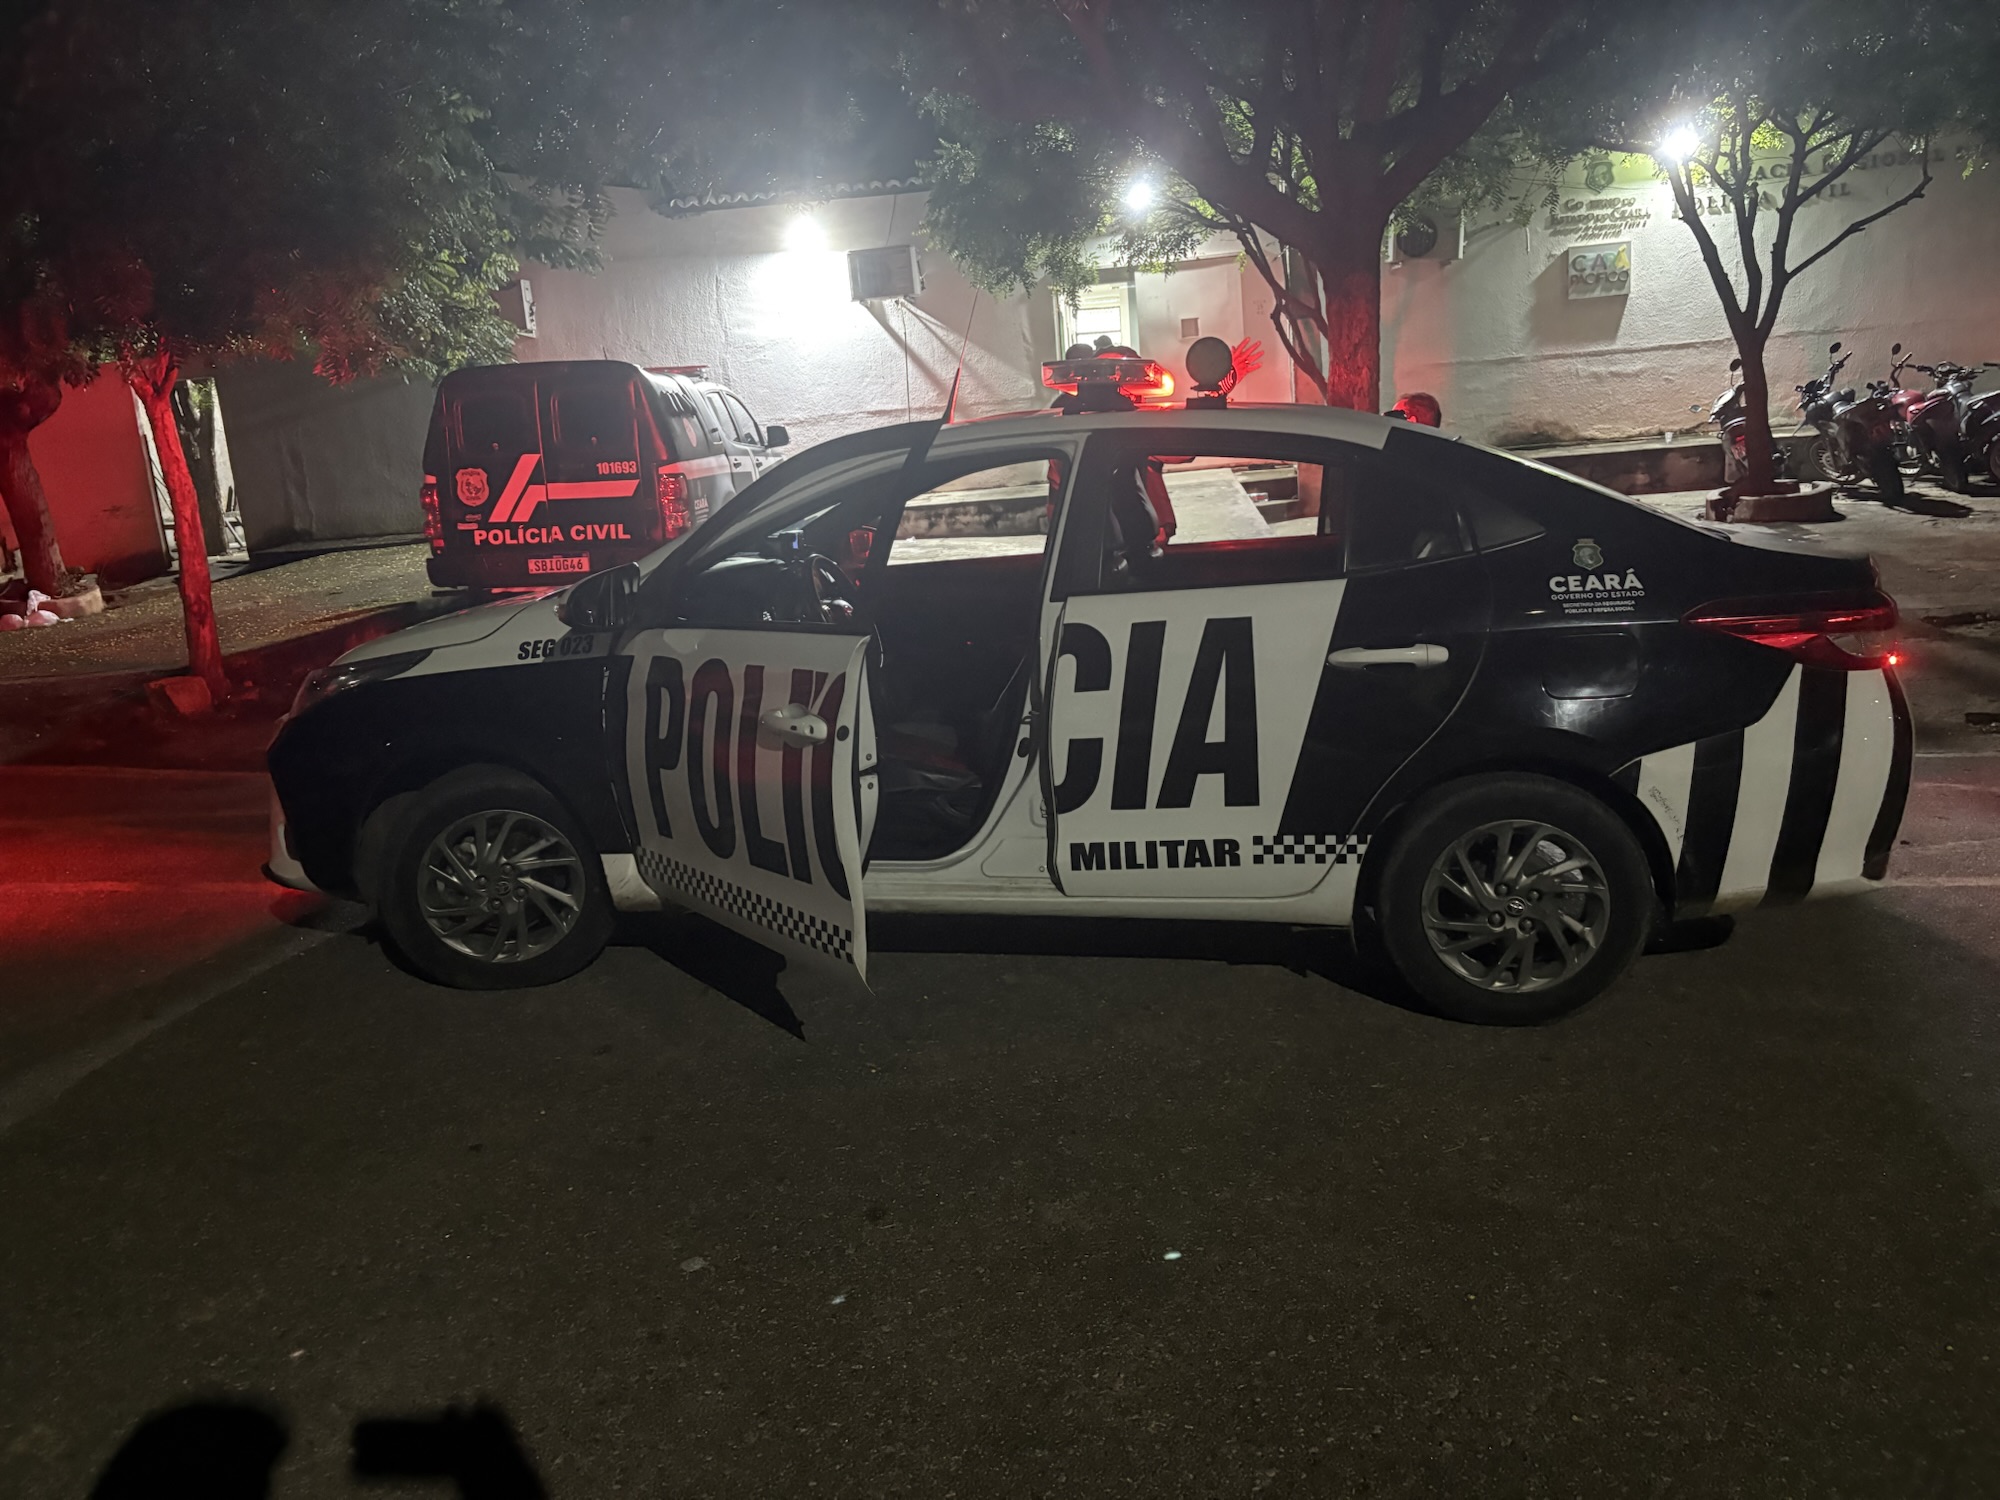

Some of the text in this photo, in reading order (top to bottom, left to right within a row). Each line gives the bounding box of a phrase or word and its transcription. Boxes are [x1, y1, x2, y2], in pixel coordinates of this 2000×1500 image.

[596, 460, 637, 475] 101693
[474, 523, 631, 546] POLÍCIA CIVIL
[1549, 568, 1644, 592] CEARÁ
[1551, 590, 1645, 601] GOVERNO DO ESTADO
[517, 634, 594, 661] SEG 023
[1069, 838, 1241, 871] MILITAR
